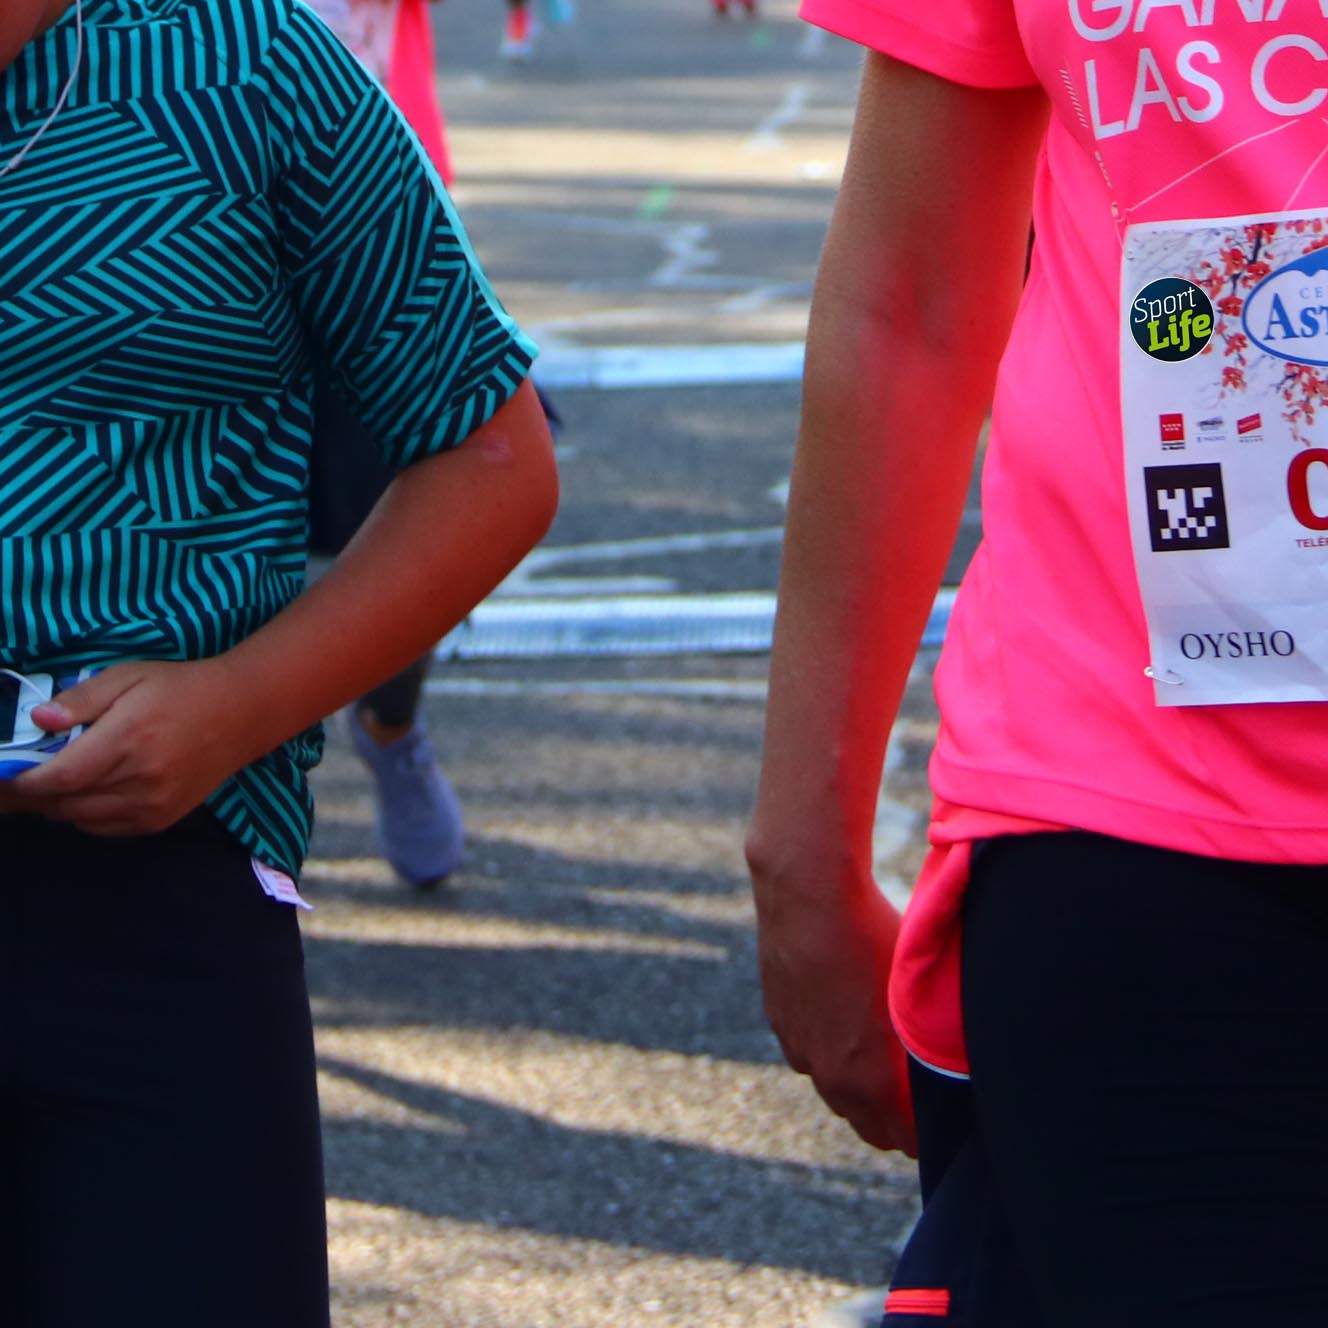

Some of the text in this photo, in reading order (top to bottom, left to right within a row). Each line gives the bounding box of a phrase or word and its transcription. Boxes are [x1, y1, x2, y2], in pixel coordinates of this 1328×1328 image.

[1083, 39, 1225, 142] LAS
[1134, 285, 1197, 324] Sport
[1147, 309, 1213, 353] Life
[1180, 630, 1296, 661] OYSHO
